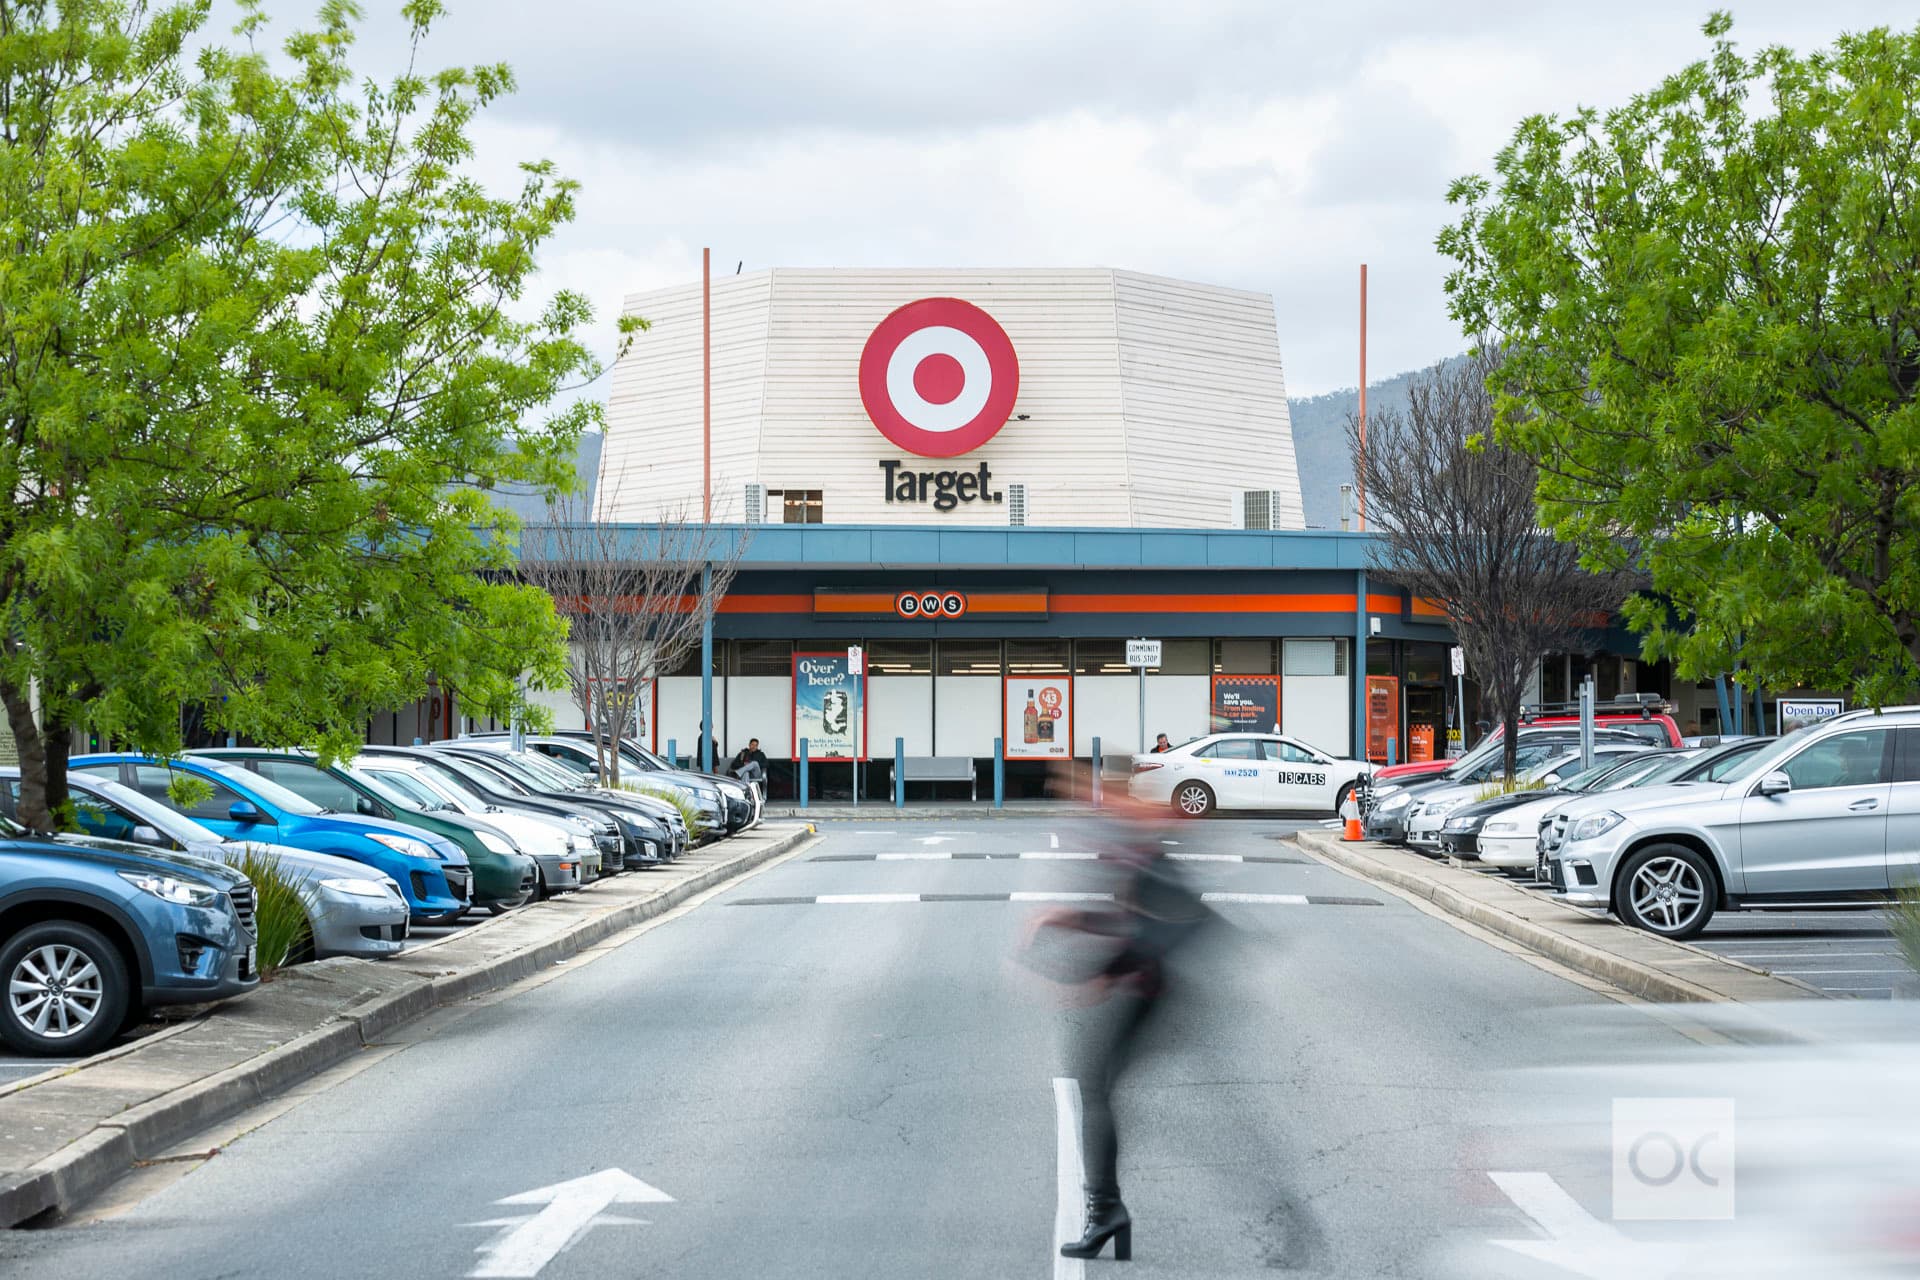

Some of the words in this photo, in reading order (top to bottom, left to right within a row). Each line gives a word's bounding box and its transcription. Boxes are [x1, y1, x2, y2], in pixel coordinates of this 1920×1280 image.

[1128, 644, 1159, 653] COMMUNITY
[1130, 654, 1141, 663] BUS
[1143, 655, 1158, 663] STOP
[808, 673, 845, 686] beer?
[1785, 705, 1813, 717] Open
[1816, 706, 1836, 716] Day
[1224, 769, 1237, 777] TAXI
[1238, 769, 1258, 777] 2520
